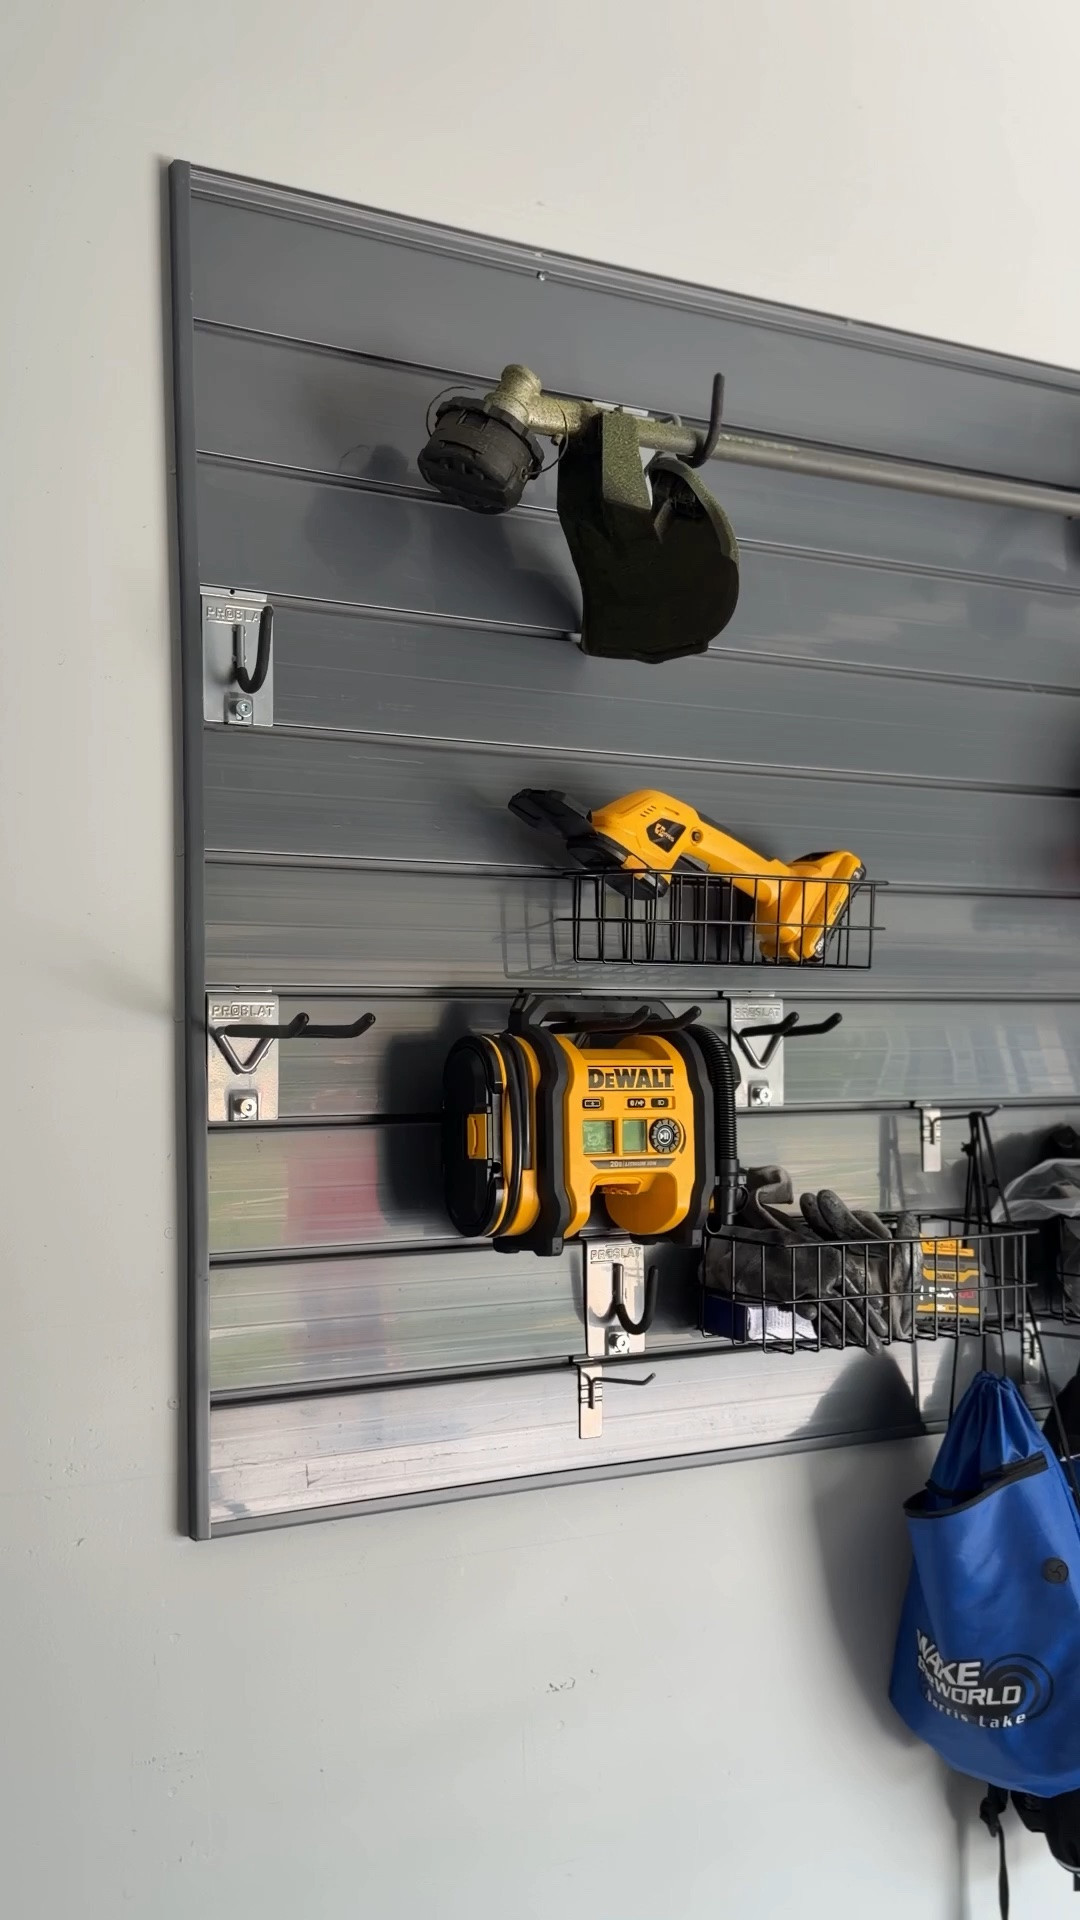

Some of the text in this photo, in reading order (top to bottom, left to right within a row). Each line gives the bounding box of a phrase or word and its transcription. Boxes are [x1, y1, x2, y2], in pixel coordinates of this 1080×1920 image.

[206, 606, 262, 622] PROSLA
[916, 1628, 981, 1686] WAKE
[979, 1713, 1026, 1728] Lake
